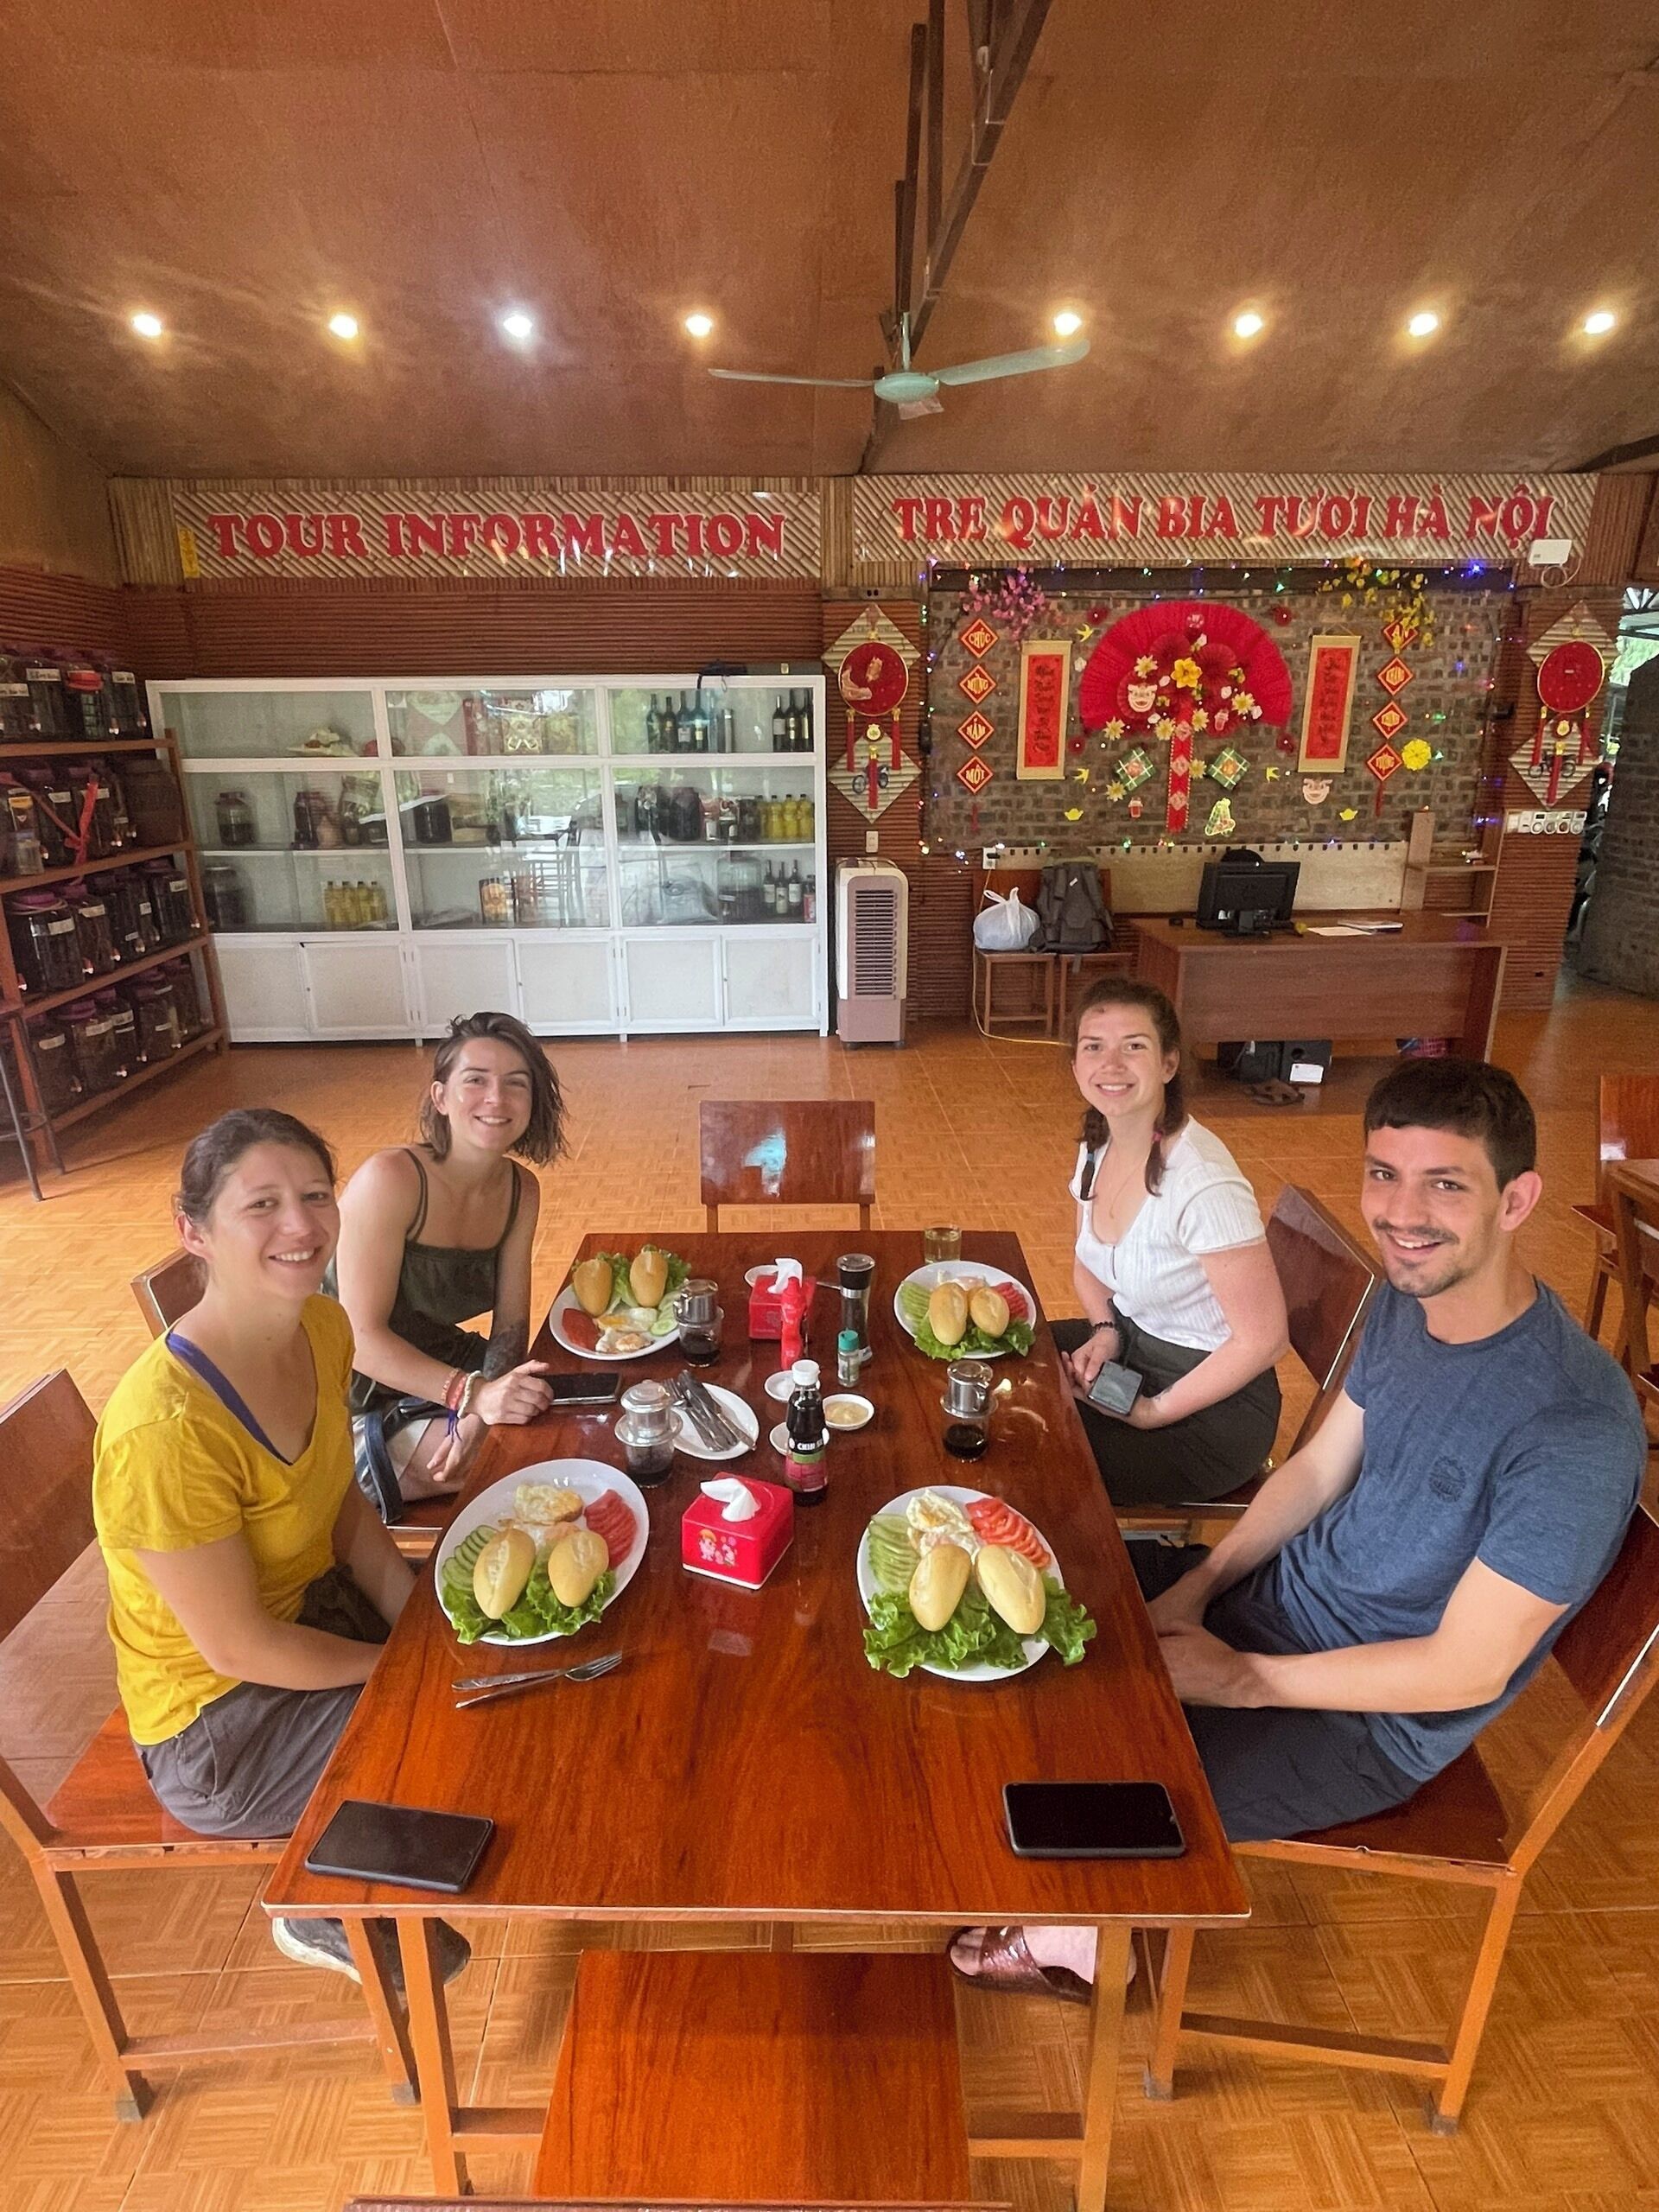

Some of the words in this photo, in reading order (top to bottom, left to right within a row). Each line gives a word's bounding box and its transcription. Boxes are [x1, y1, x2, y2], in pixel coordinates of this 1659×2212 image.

[207, 512, 371, 558] TOUR
[384, 512, 786, 559] INFORMATION
[892, 497, 988, 541] TRE
[1154, 495, 1243, 539] BIA
[1255, 487, 1376, 539] TƯƠI
[1382, 483, 1453, 540] HÀ
[1465, 482, 1557, 550] NỘI
[968, 627, 991, 649] CHÚC
